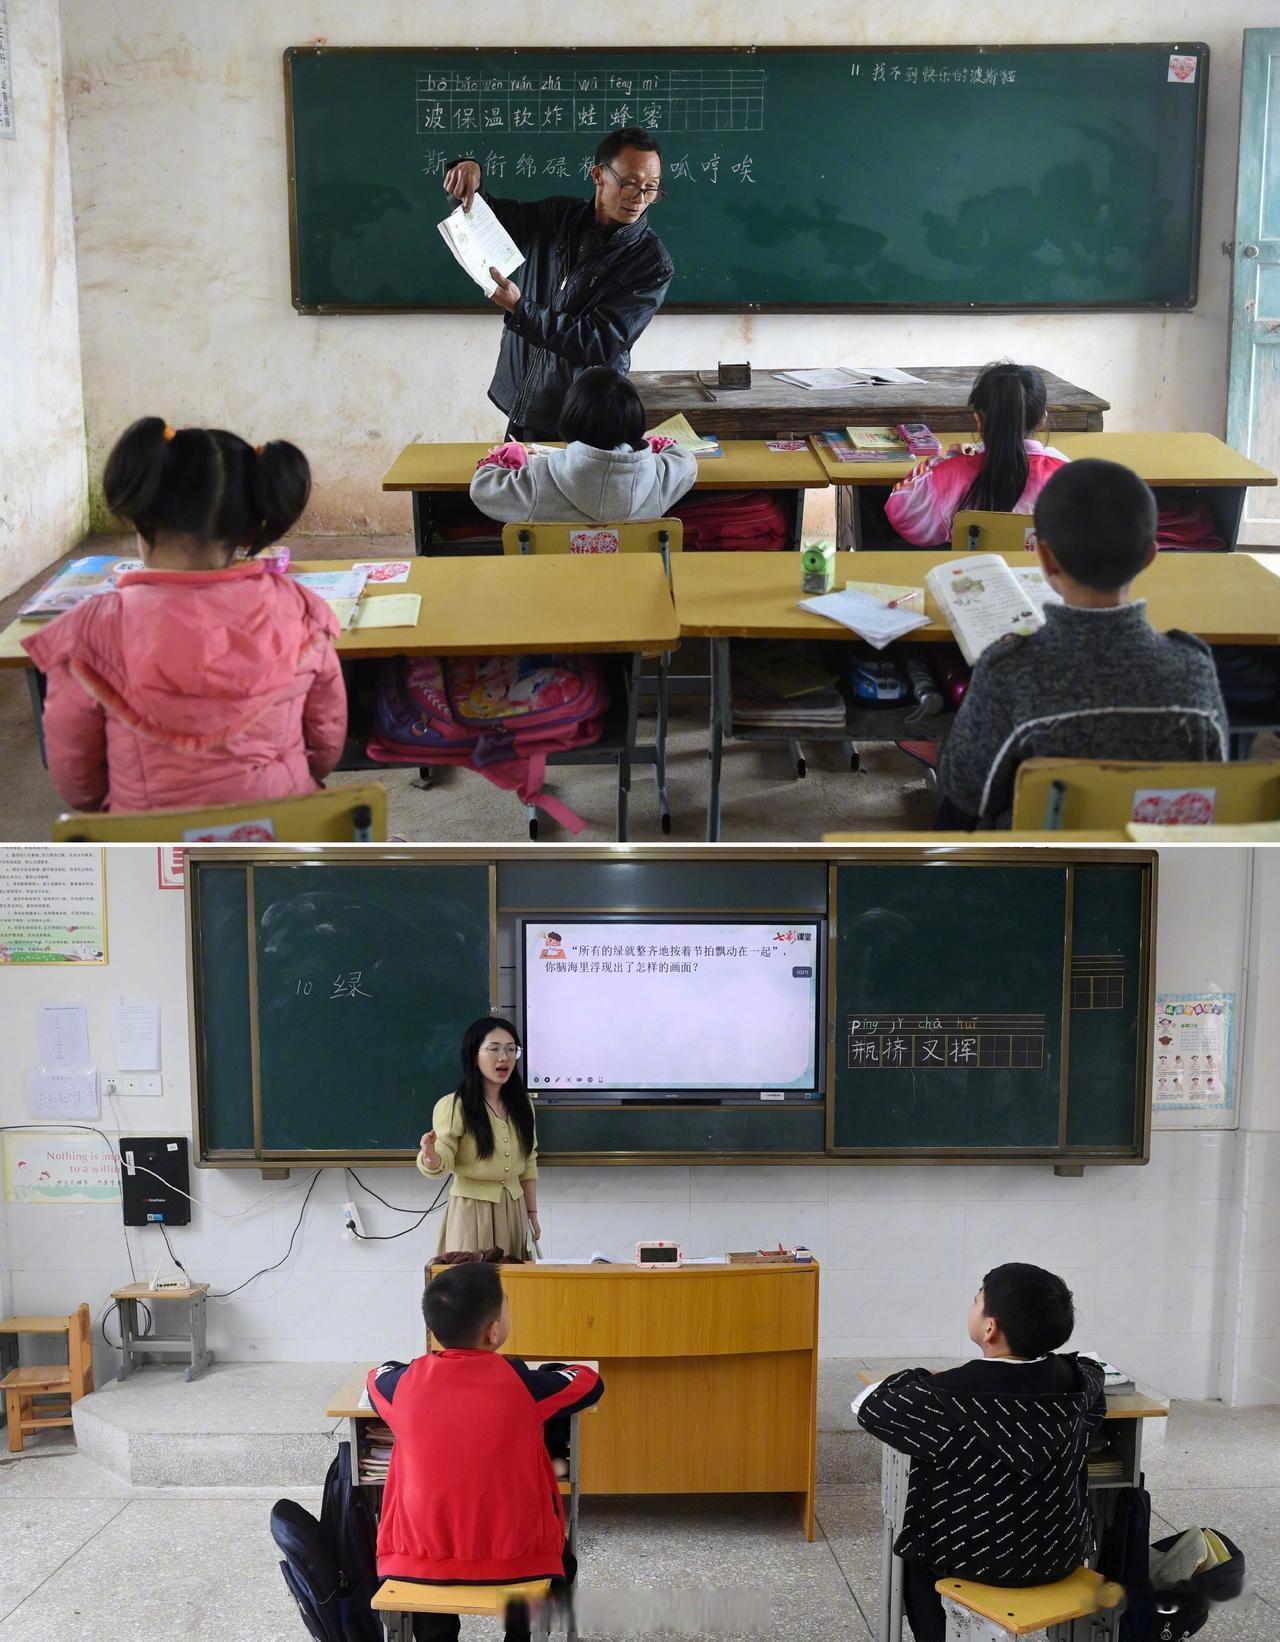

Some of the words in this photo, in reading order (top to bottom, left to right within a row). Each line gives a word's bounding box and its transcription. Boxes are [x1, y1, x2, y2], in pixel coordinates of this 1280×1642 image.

[296, 979, 313, 996] 10
[329, 971, 374, 999] 绿
[47, 1152, 88, 1163] Nothing
[70, 1165, 81, 1173] to
